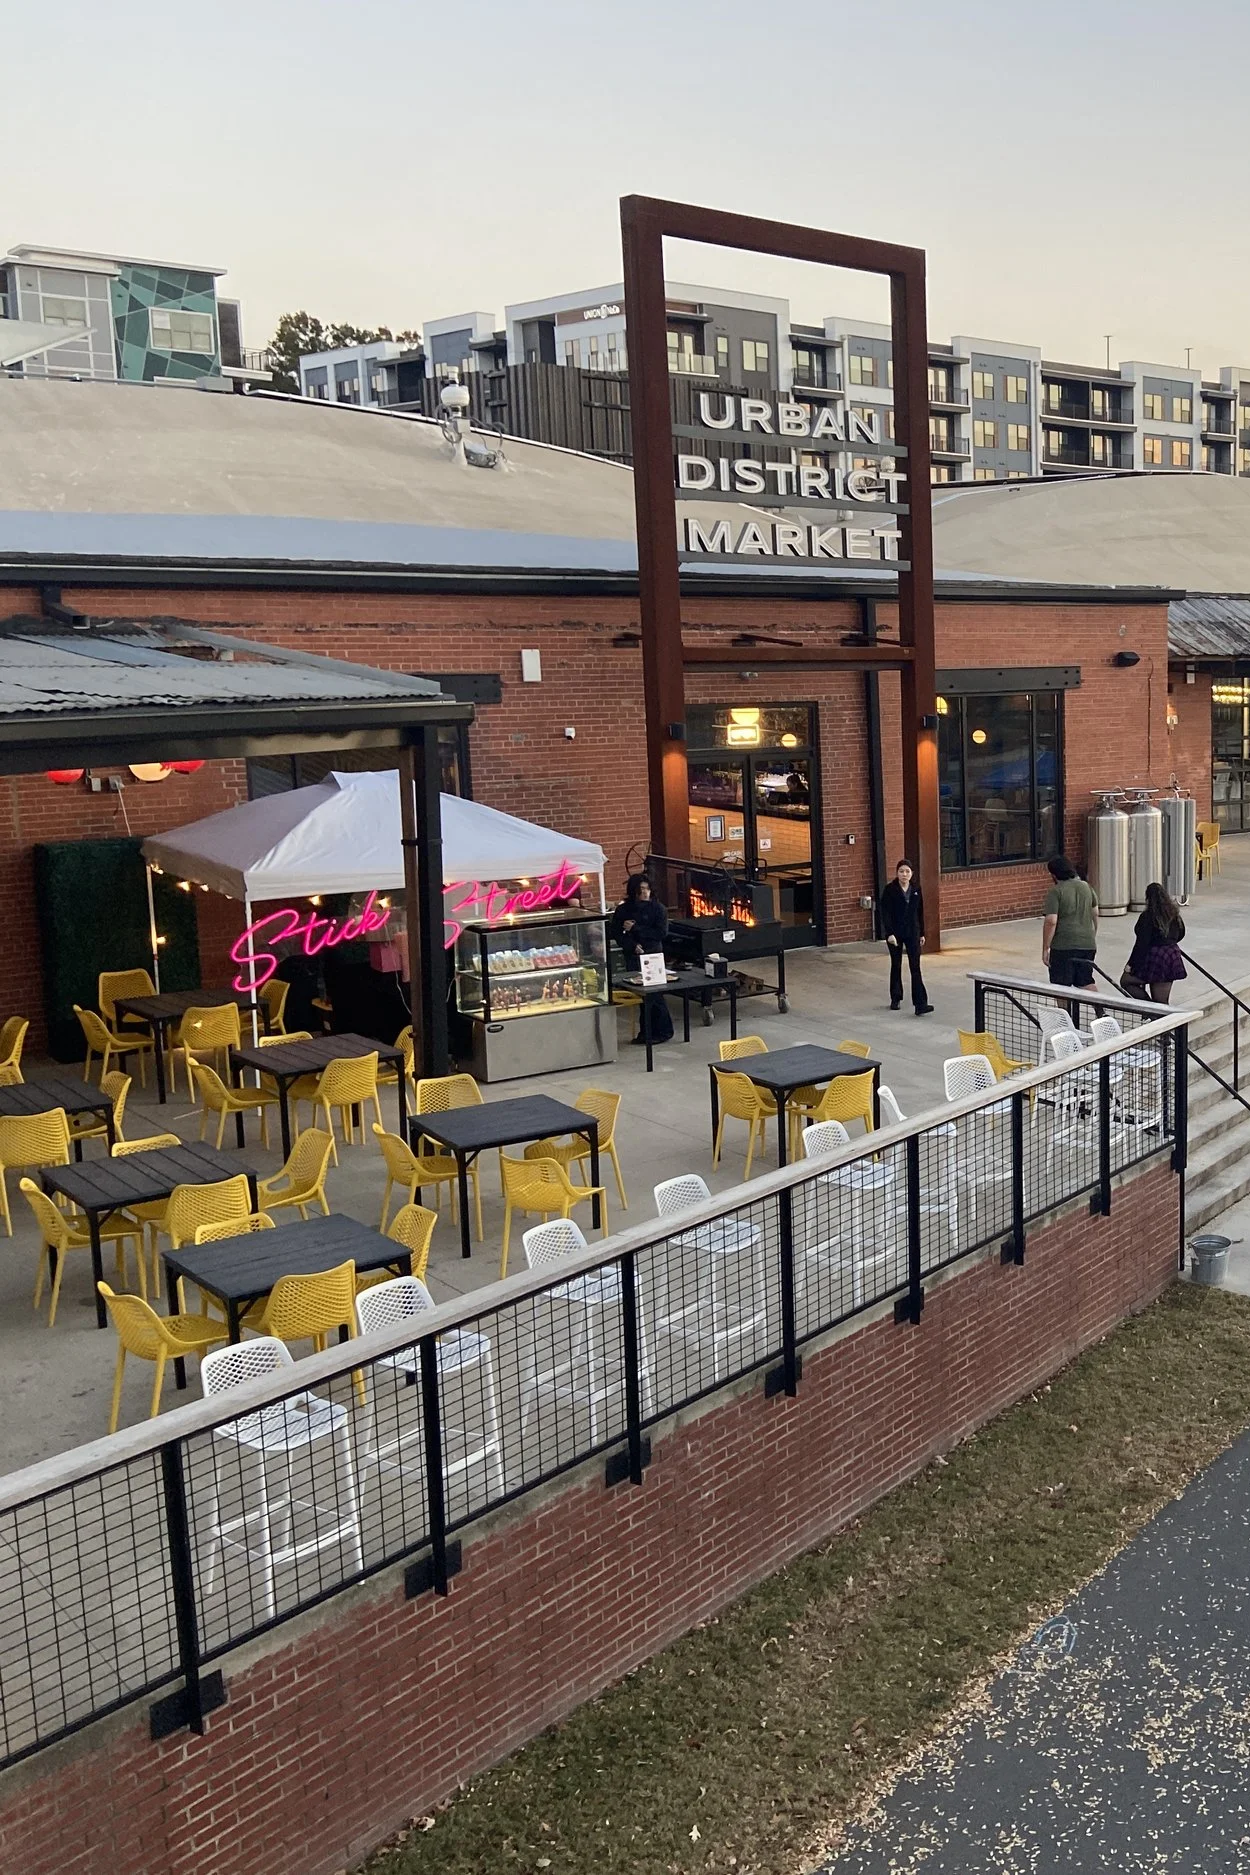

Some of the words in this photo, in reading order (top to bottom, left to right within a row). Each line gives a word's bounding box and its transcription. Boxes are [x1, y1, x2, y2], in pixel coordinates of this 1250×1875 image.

[699, 392, 880, 445] URBAN
[677, 454, 907, 504] DISTRICT
[685, 518, 903, 561] MARKET
[229, 888, 391, 993] Stick
